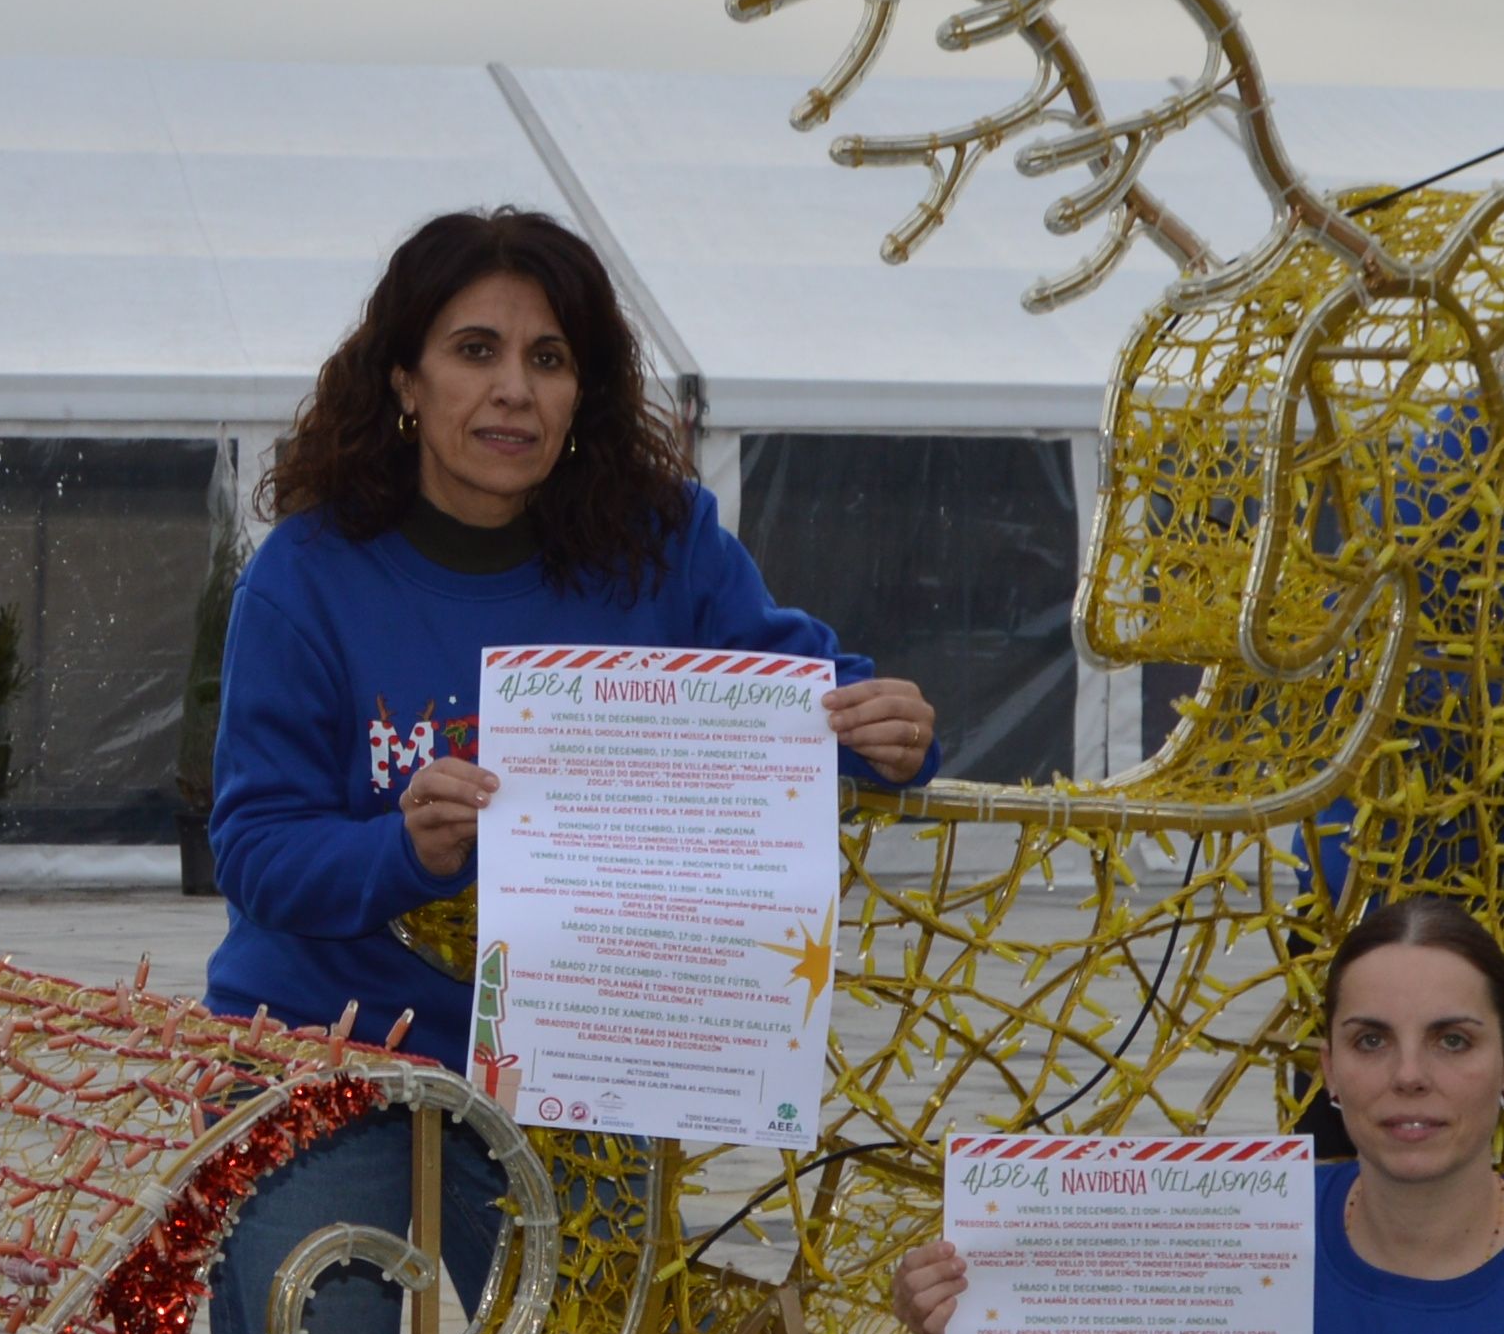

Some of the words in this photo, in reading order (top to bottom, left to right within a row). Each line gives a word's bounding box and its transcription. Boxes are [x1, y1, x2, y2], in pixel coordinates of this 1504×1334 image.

[495, 671, 583, 706] ALDEA
[594, 675, 677, 707] NAVIDEÑA
[679, 678, 812, 714] VILALONGA
[767, 1120, 802, 1133] AEEA
[959, 1163, 1049, 1197] ALDEA
[1061, 1167, 1147, 1197] NAVIDEÑA
[1150, 1166, 1288, 1199] VILALONGA
